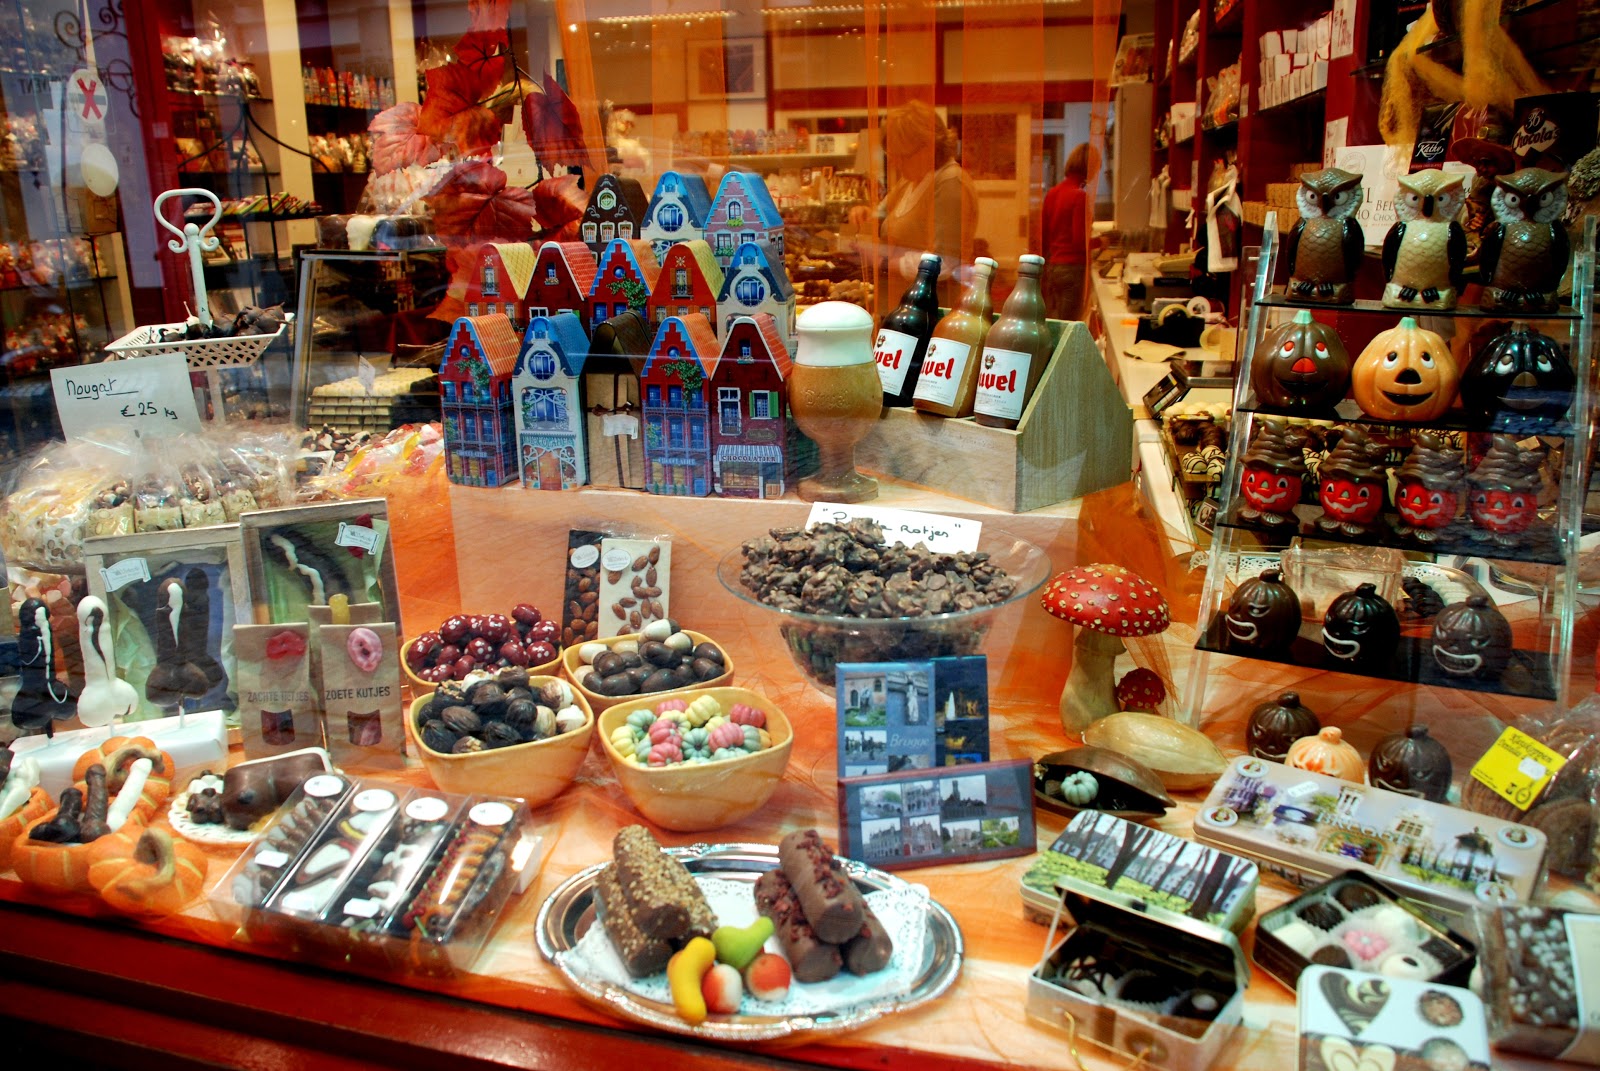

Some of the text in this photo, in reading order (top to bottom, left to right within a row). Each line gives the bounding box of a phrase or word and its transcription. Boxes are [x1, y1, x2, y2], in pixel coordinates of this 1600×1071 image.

[919, 357, 955, 380] uvel
[978, 369, 1017, 393] uvel
[325, 685, 391, 701] ZOETE KUTJES
